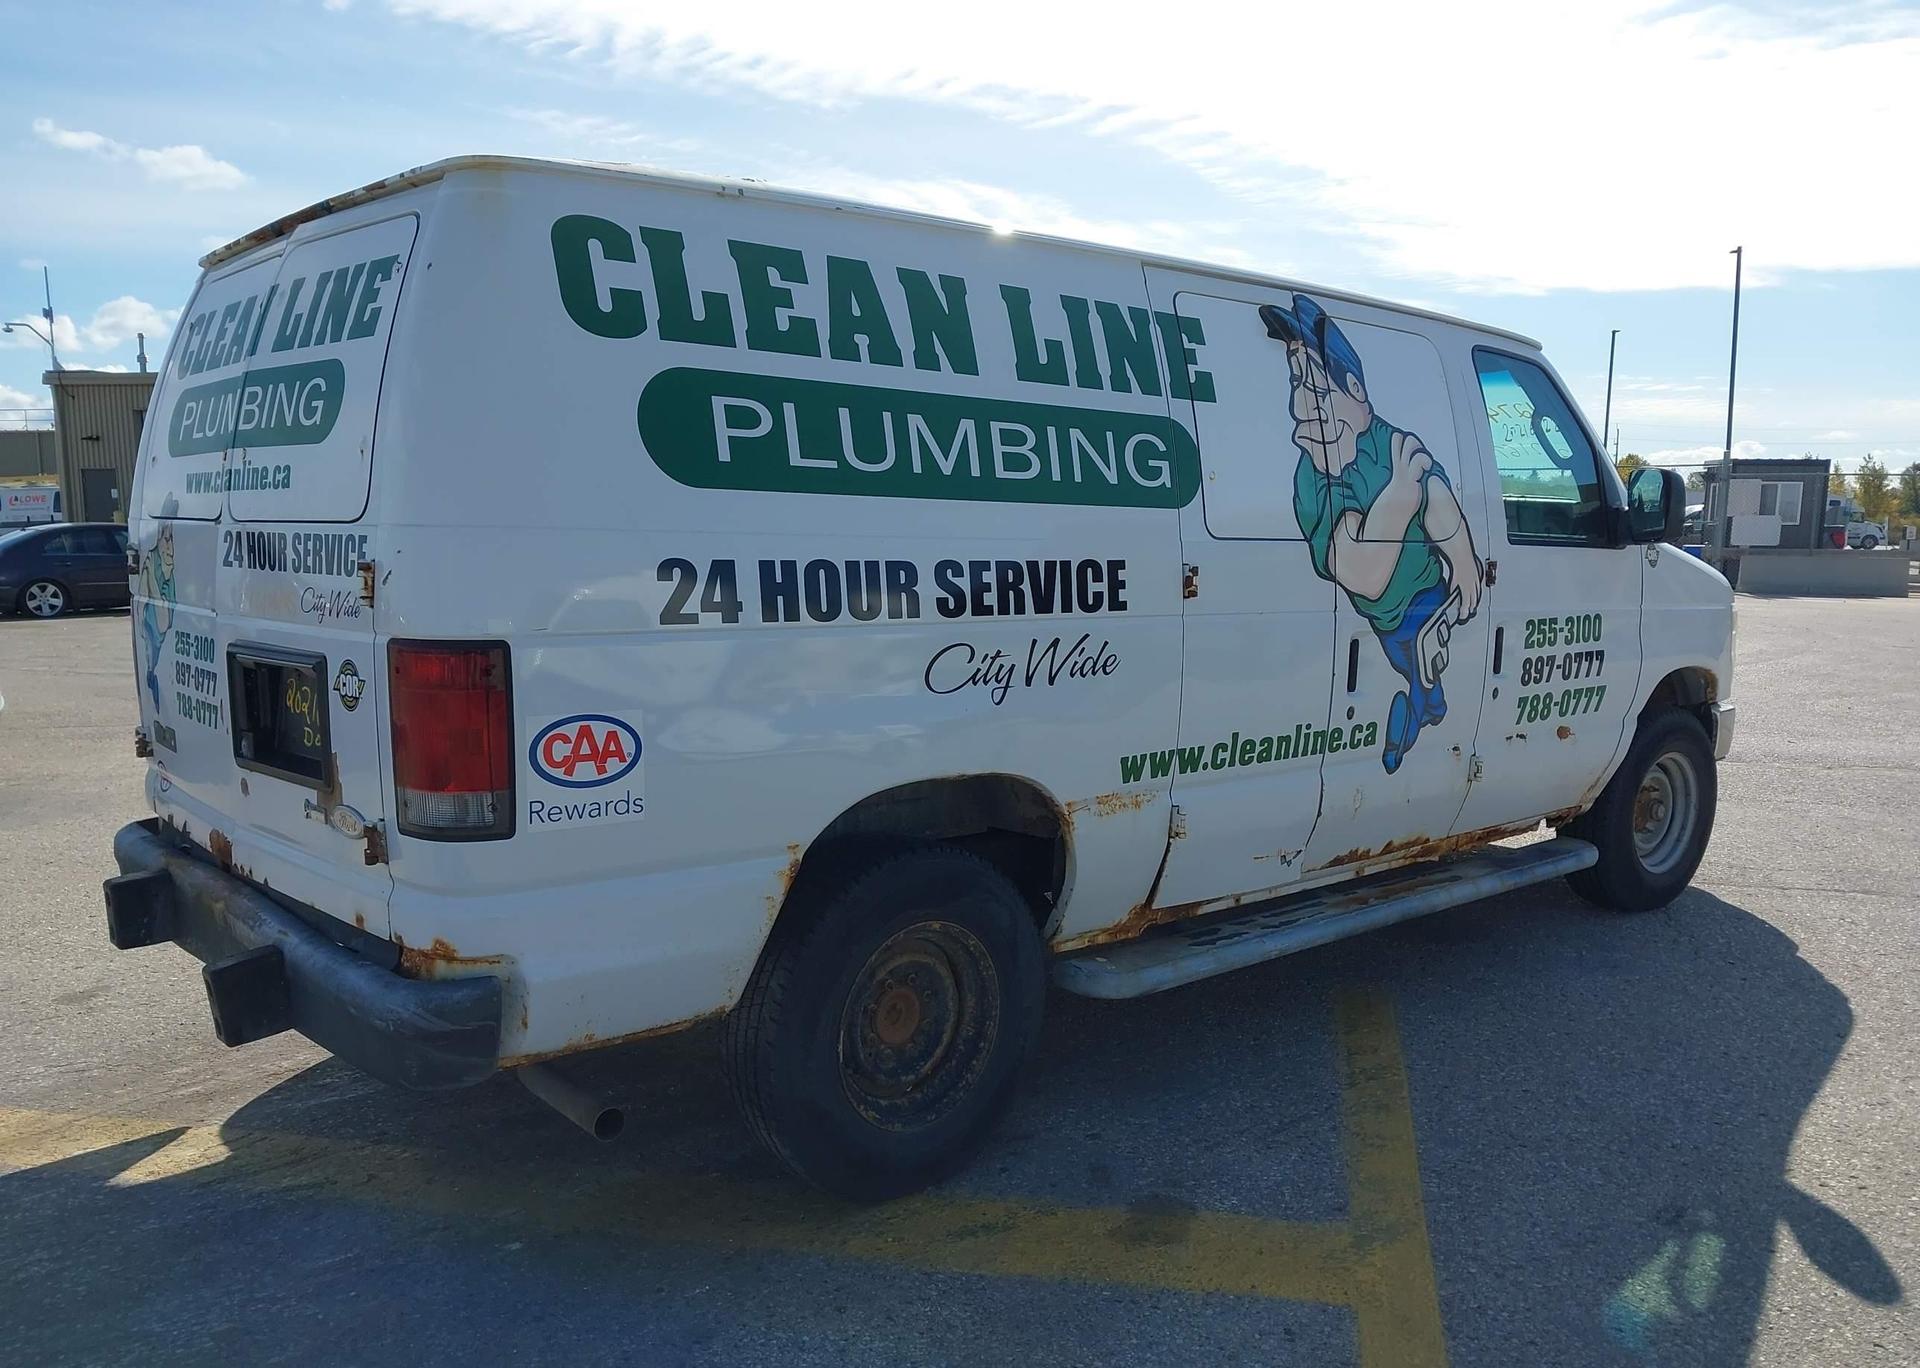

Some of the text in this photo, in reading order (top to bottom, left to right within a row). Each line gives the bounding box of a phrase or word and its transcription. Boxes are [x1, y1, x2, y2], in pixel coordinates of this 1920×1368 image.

[271, 253, 400, 354] LINE
[550, 213, 1218, 404] CLEAN LINE
[711, 394, 1174, 488] PLUMBING
[186, 459, 291, 494] www.clanline.ca
[222, 530, 368, 578] 24 HOUR SERVICE
[328, 589, 361, 619] Wide
[656, 557, 1128, 627] 24 HOUR SERVICE
[175, 630, 215, 664] 255-3100
[1524, 613, 1602, 650] 255-3100
[175, 660, 217, 697] 897-0777
[924, 633, 1121, 706] City Wide
[1520, 649, 1605, 688] 897-0777
[176, 691, 218, 730] 788-0777
[1515, 684, 1607, 726] 788-0777
[543, 724, 628, 777] CAA
[1120, 721, 1378, 784] www.cleanline.ca
[529, 790, 644, 825] Rewards
